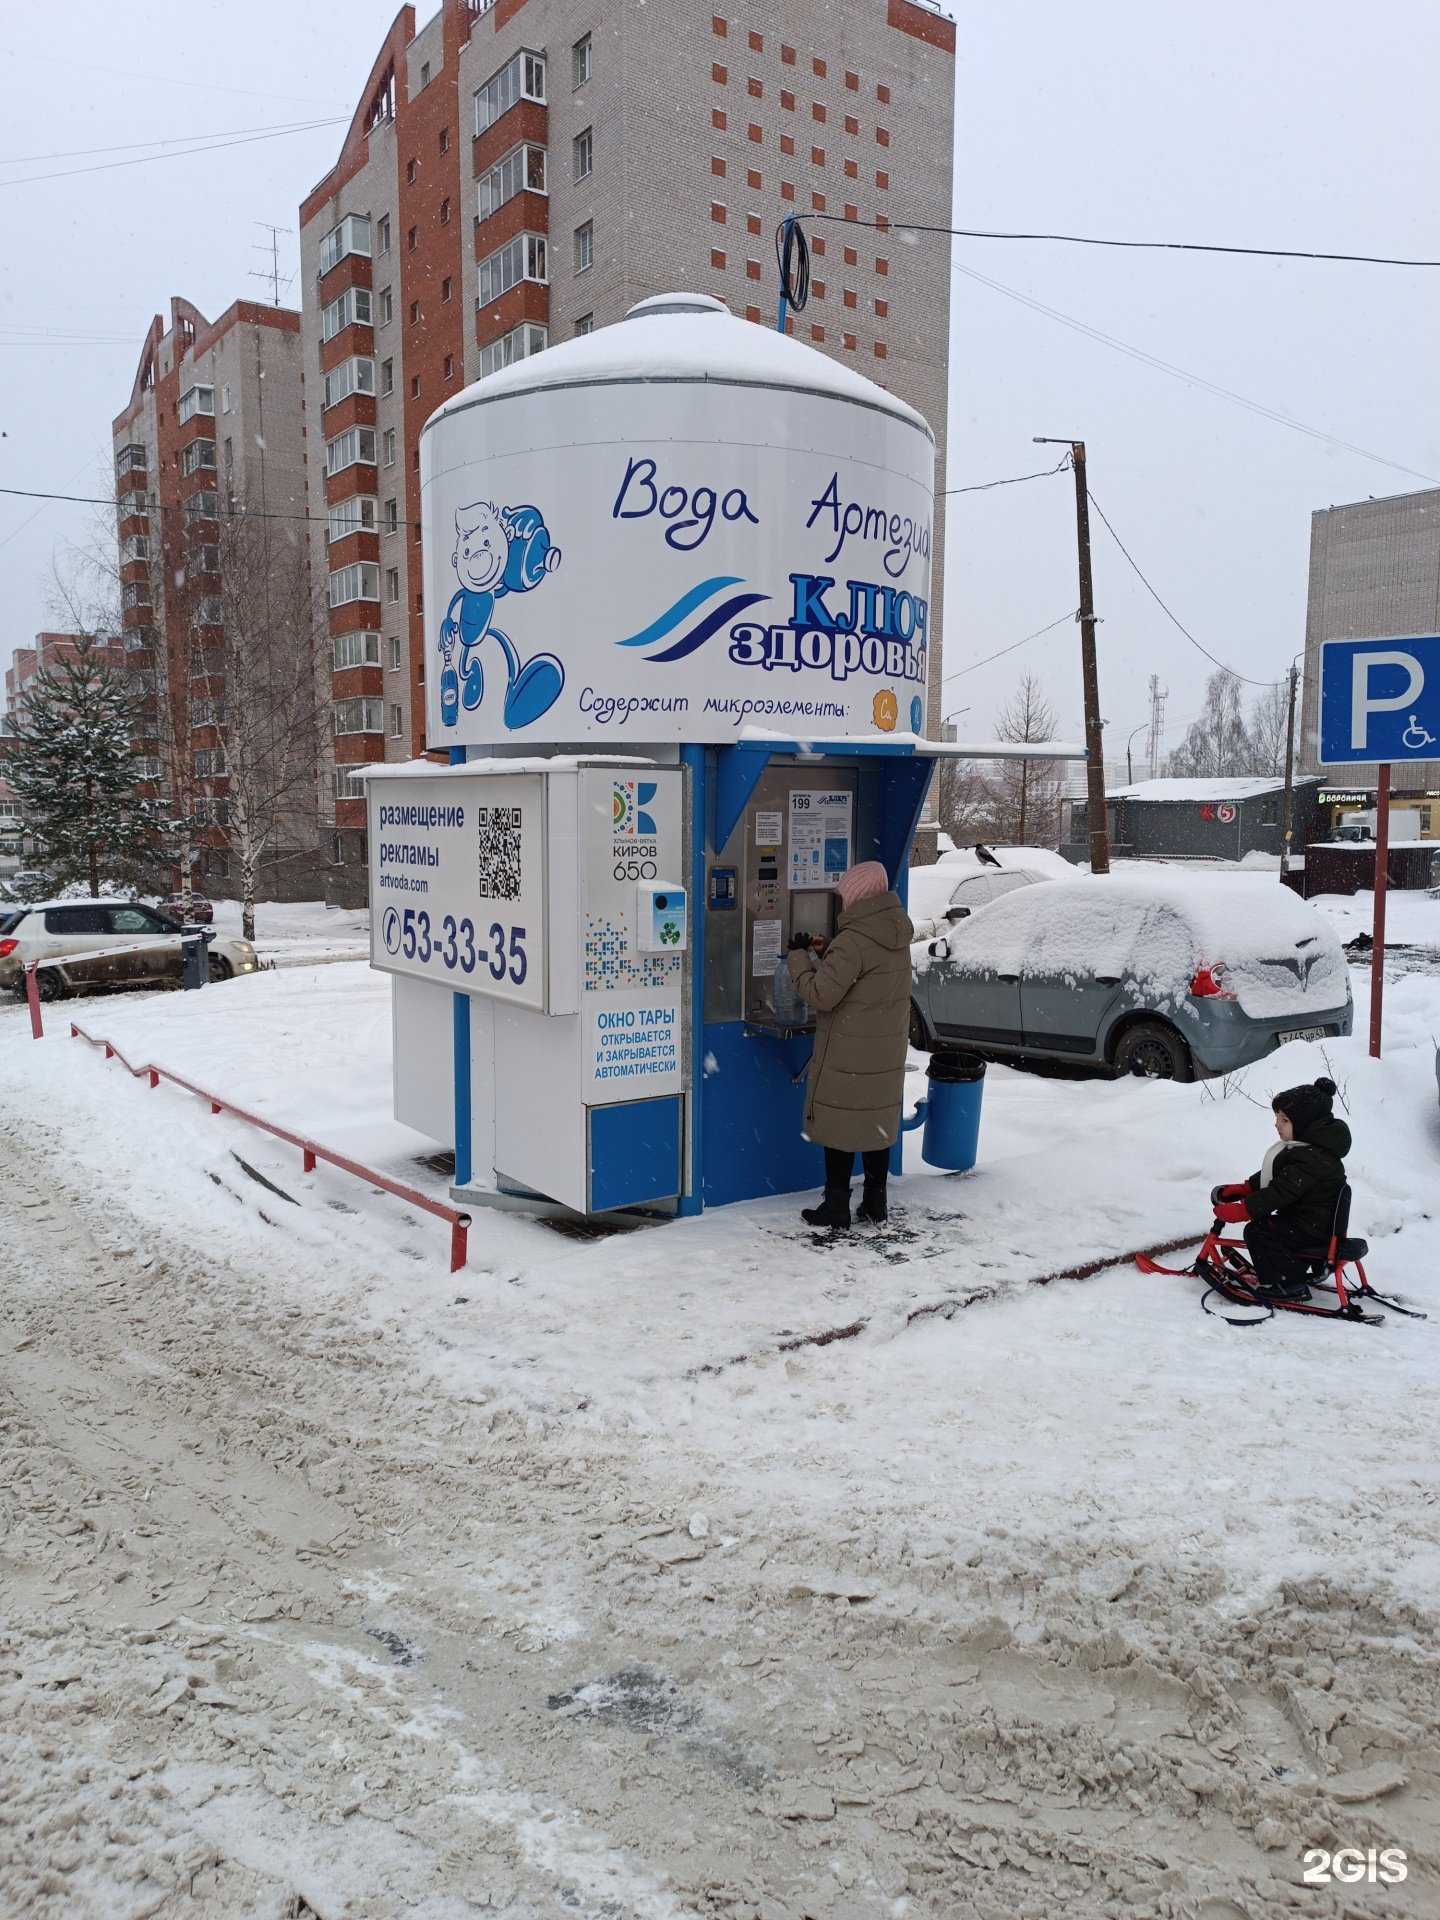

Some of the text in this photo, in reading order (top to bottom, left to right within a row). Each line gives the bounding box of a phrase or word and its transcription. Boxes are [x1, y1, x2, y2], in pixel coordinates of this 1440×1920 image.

[612, 457, 759, 551] Вода
[579, 687, 850, 725] Содержит микроэлементы:
[1351, 651, 1425, 749] P
[792, 798, 810, 809] 199
[379, 805, 465, 830] размещение
[379, 841, 440, 867] рекламы
[613, 846, 657, 857] КИРОВ
[613, 861, 657, 881] 650
[380, 873, 429, 893] artvoda.com
[402, 908, 527, 985] 53-33-35
[597, 1008, 675, 1029] ОКНО ТАРЫ
[601, 1029, 671, 1046] ОТКРЫВАЕТСЯ
[596, 1045, 675, 1062] И ЗАКРЫВАЕТСЯ
[594, 1060, 676, 1079] АВТОМАТИЧЕСКИ
